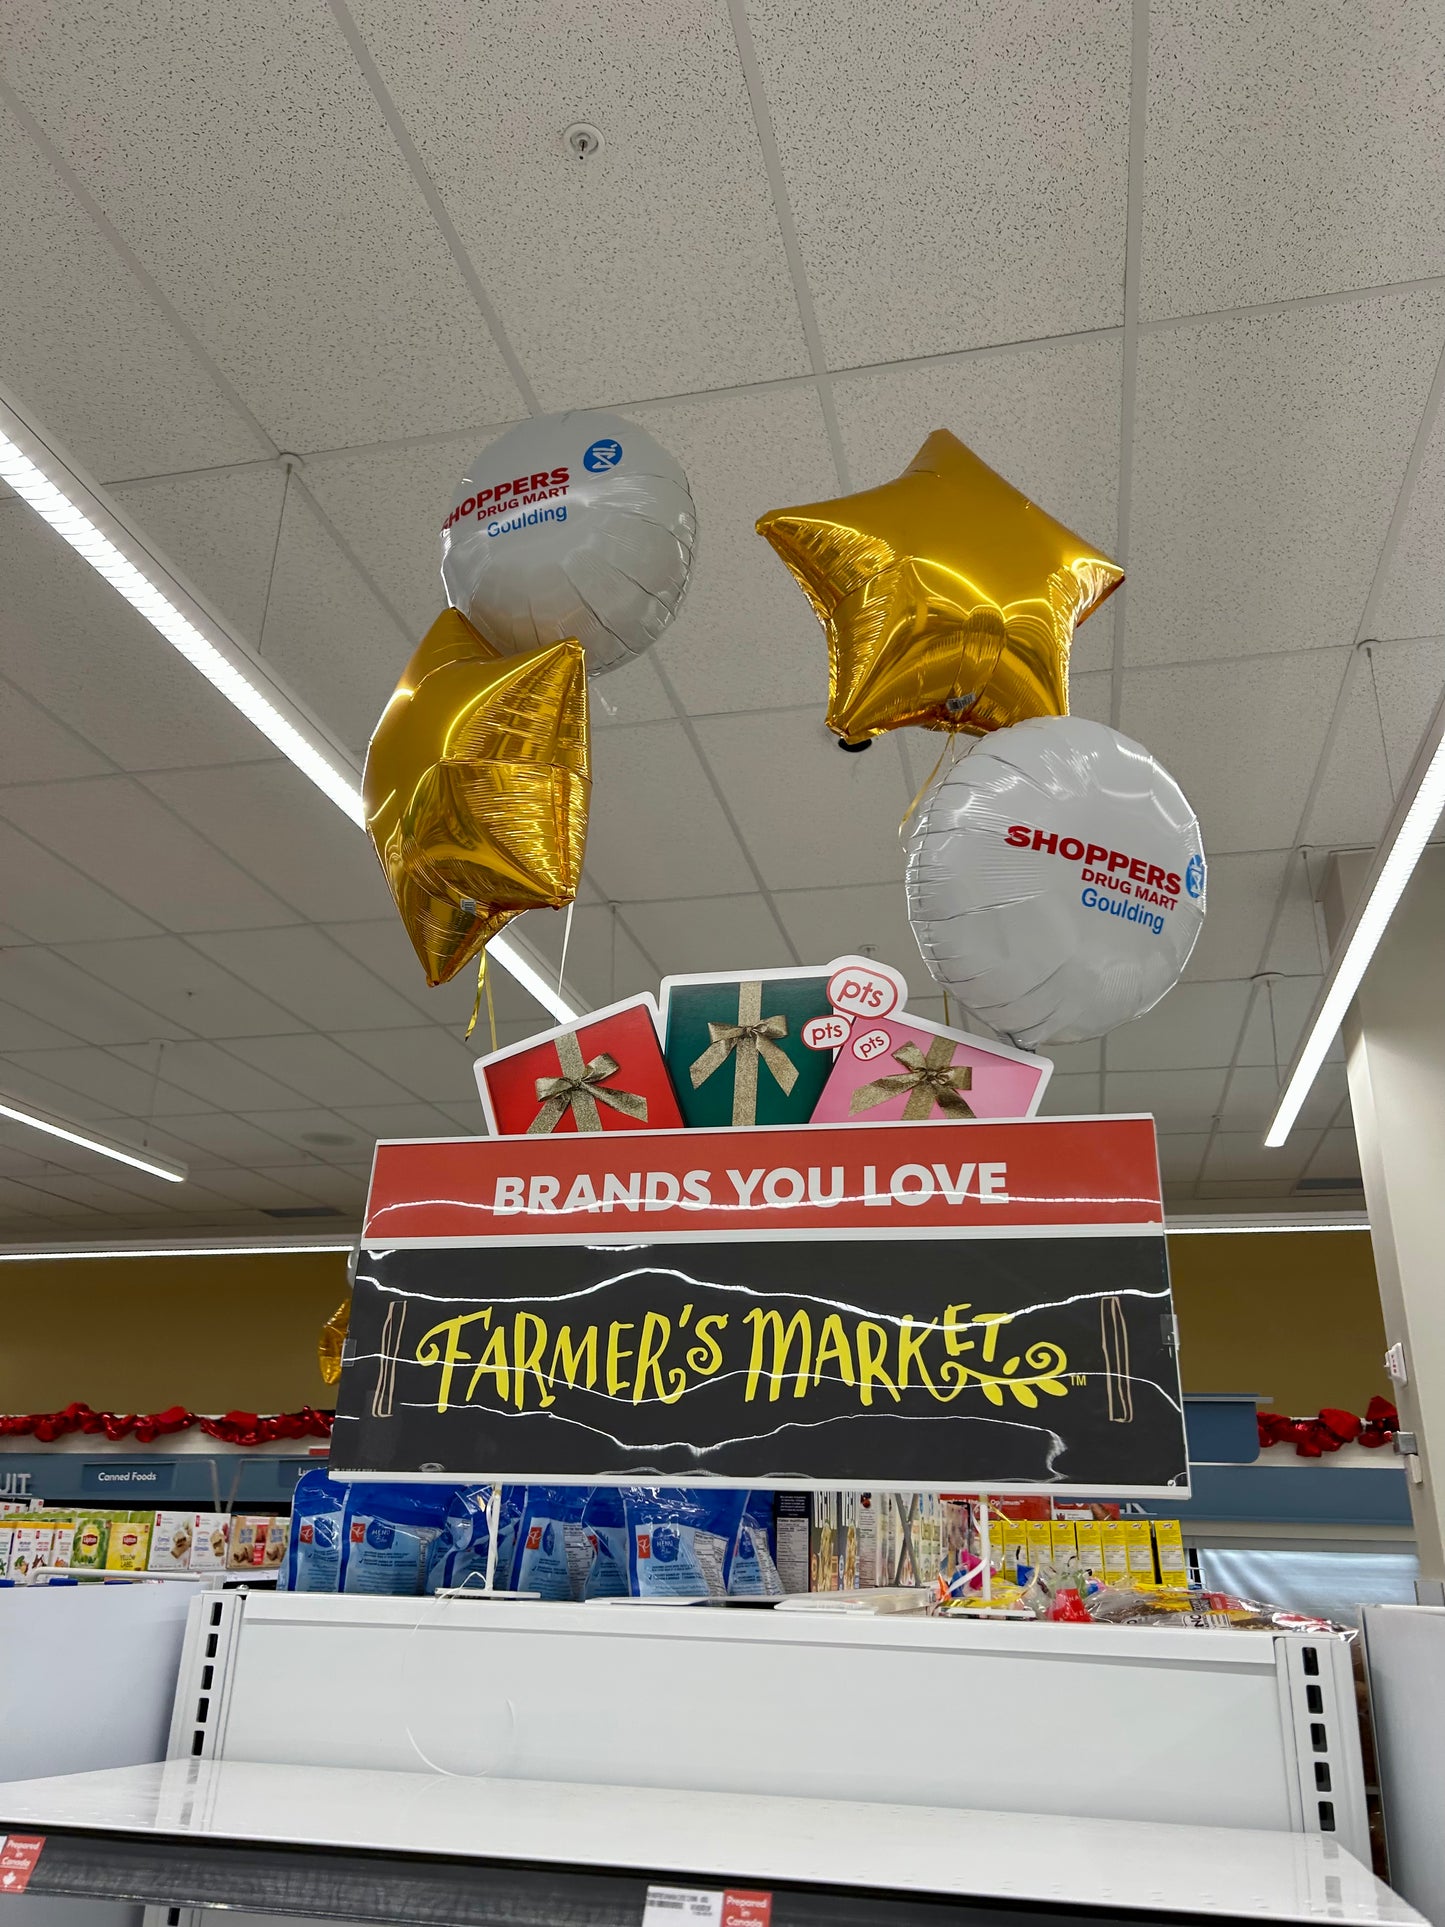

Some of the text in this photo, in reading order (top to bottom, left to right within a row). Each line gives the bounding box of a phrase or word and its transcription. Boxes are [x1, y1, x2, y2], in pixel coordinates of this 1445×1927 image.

[477, 485, 570, 521] DRUG MART
[487, 505, 568, 538] Goulding
[1004, 825, 1182, 896] SHOPPERS
[1081, 867, 1178, 911] DRUG MART
[1081, 887, 1165, 935] Goulding
[836, 979, 884, 1008] pts
[811, 1022, 843, 1046] pts
[859, 1034, 885, 1059] pts
[493, 1162, 1009, 1216] BRANDS YOU LOVE
[416, 1303, 730, 1413] FARMER'S
[744, 1303, 1017, 1409] MARKET
[97, 1471, 157, 1483] Canned Foods
[5, 1839, 40, 1851] Prepared
[0, 1856, 31, 1868] Canada
[725, 1895, 768, 1909] Prepared
[725, 1915, 763, 1927] Canada
